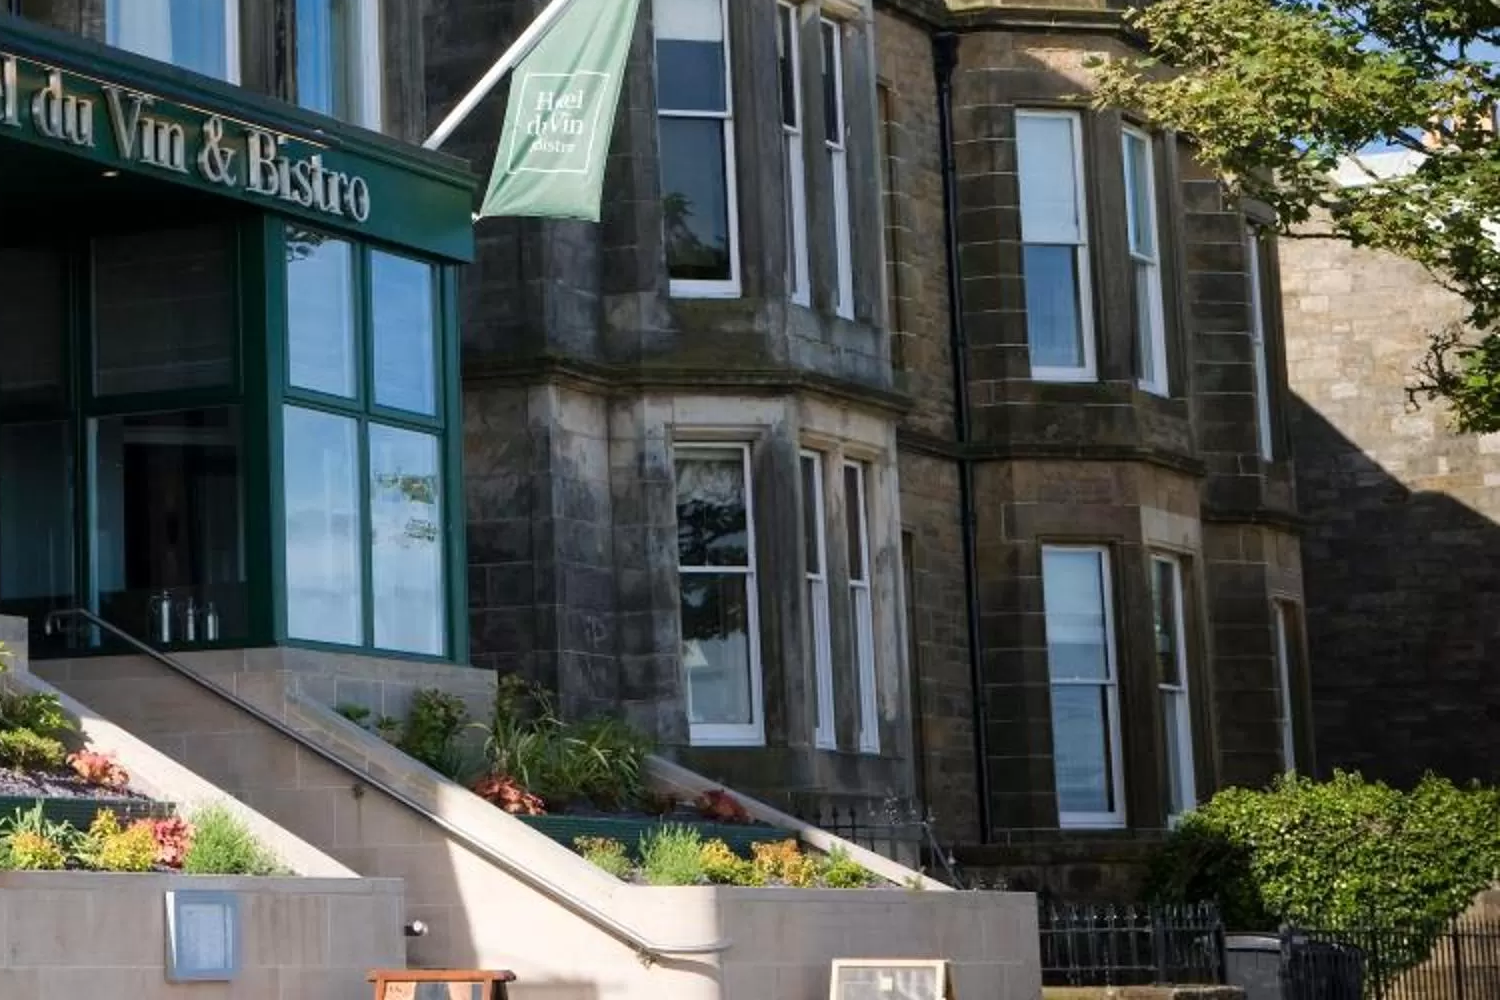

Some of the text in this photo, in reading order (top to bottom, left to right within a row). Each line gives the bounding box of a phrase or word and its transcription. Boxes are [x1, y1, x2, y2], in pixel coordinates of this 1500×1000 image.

[32, 67, 95, 148] du
[104, 85, 189, 174] Vin
[200, 114, 238, 187] &
[245, 127, 371, 222] Bistro
